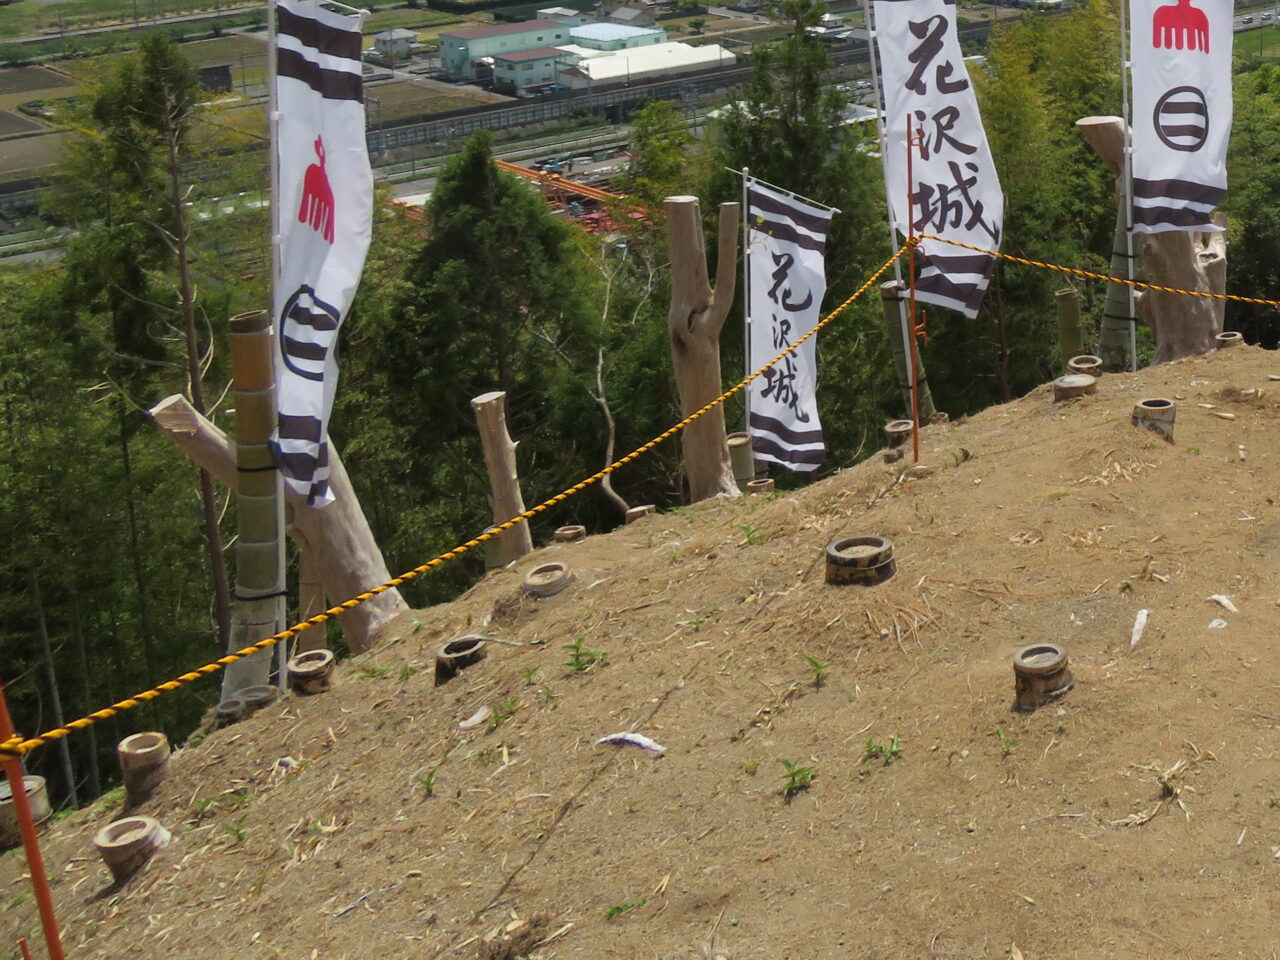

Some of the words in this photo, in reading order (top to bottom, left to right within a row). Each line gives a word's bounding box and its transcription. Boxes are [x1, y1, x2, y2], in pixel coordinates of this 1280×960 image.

[904, 14, 999, 245] 花沢城
[760, 250, 813, 424] 花沢城
